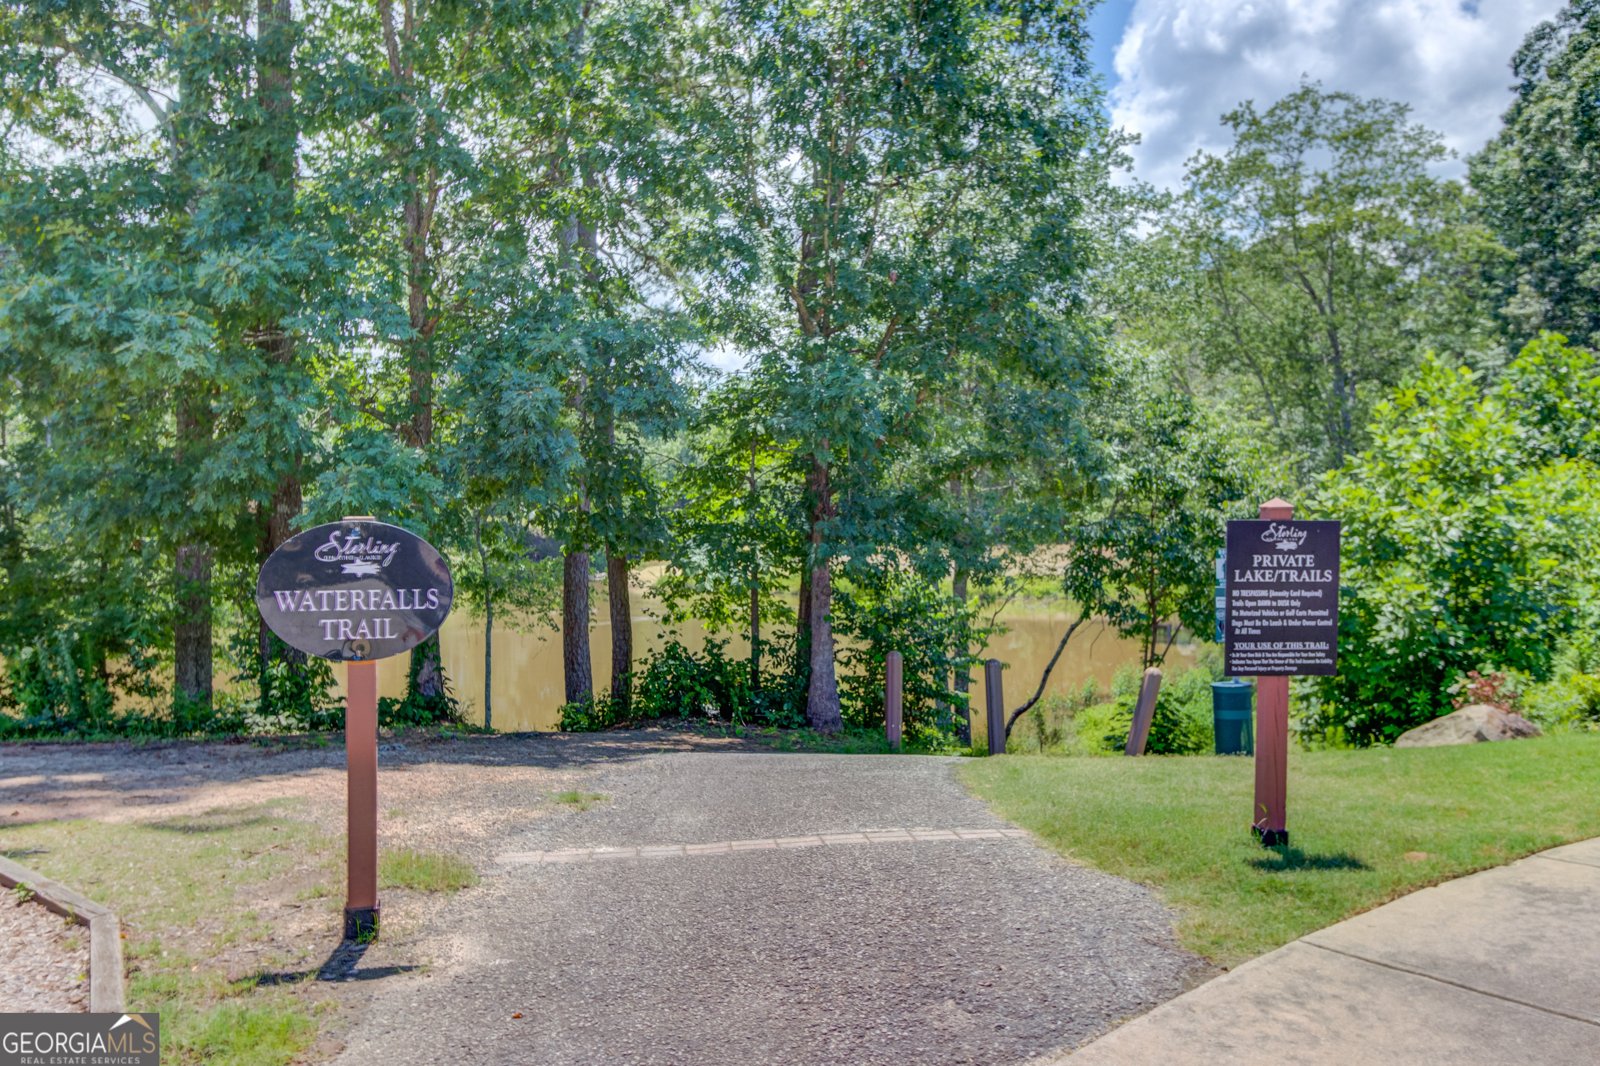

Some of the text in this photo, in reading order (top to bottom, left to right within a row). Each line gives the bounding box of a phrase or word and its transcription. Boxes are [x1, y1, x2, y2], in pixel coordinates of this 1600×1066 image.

[1261, 522, 1307, 545] Sterling
[314, 530, 400, 567] Sterling
[1252, 554, 1315, 567] PRIVATE
[1234, 570, 1332, 583] LAKE/TRAILS
[273, 588, 439, 612] WATERFALLS
[318, 618, 400, 640] TRAIL
